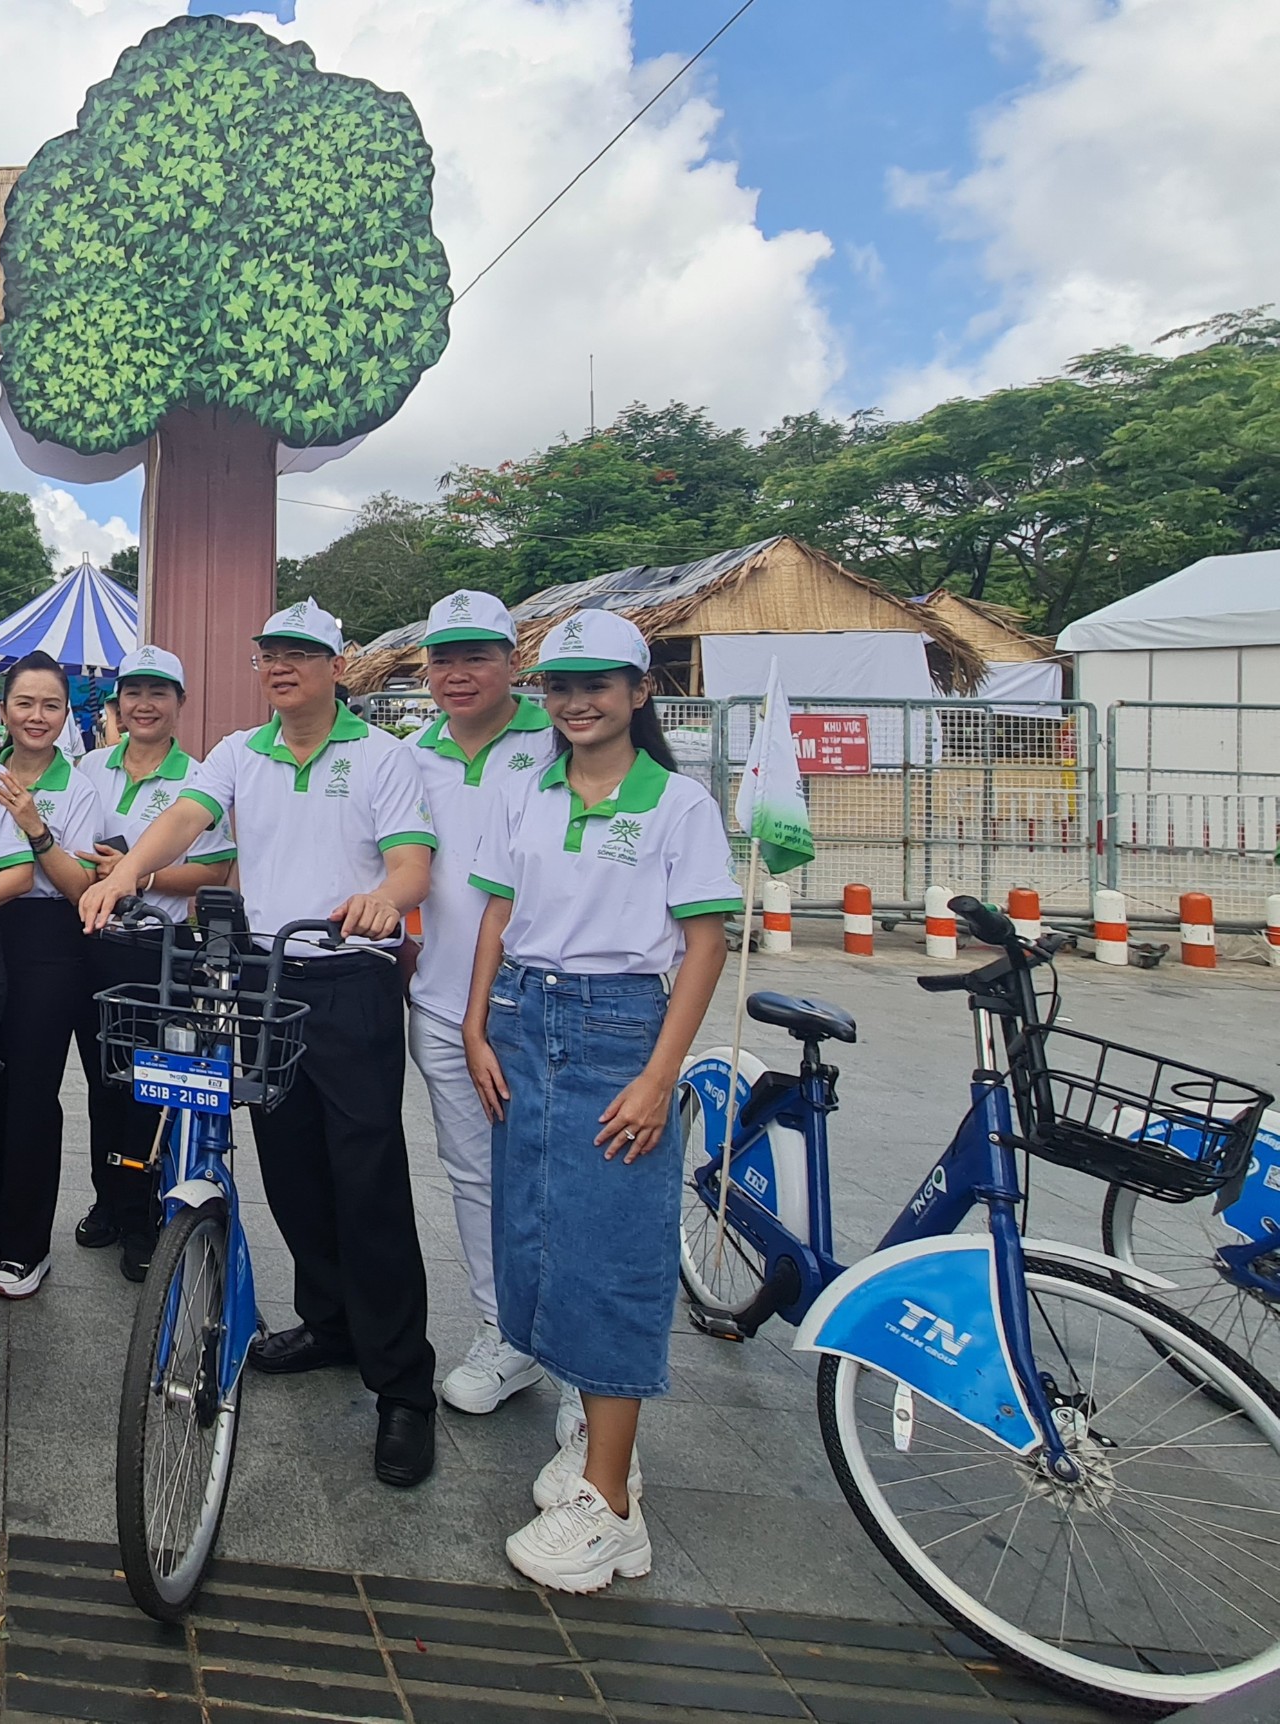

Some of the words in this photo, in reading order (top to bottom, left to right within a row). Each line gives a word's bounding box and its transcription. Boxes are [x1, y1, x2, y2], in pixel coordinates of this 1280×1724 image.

[823, 721, 841, 733] KHU
[843, 720, 861, 734] VỰC
[792, 730, 816, 759] ẤM
[140, 1083, 170, 1099] X51B
[179, 1089, 219, 1107] 21.618
[910, 1164, 948, 1216] TNGO
[898, 1298, 972, 1357] TN
[884, 1321, 900, 1335] TRI
[901, 1331, 925, 1348] NAM
[924, 1344, 959, 1367] GROUP
[586, 1535, 602, 1548] FILA
